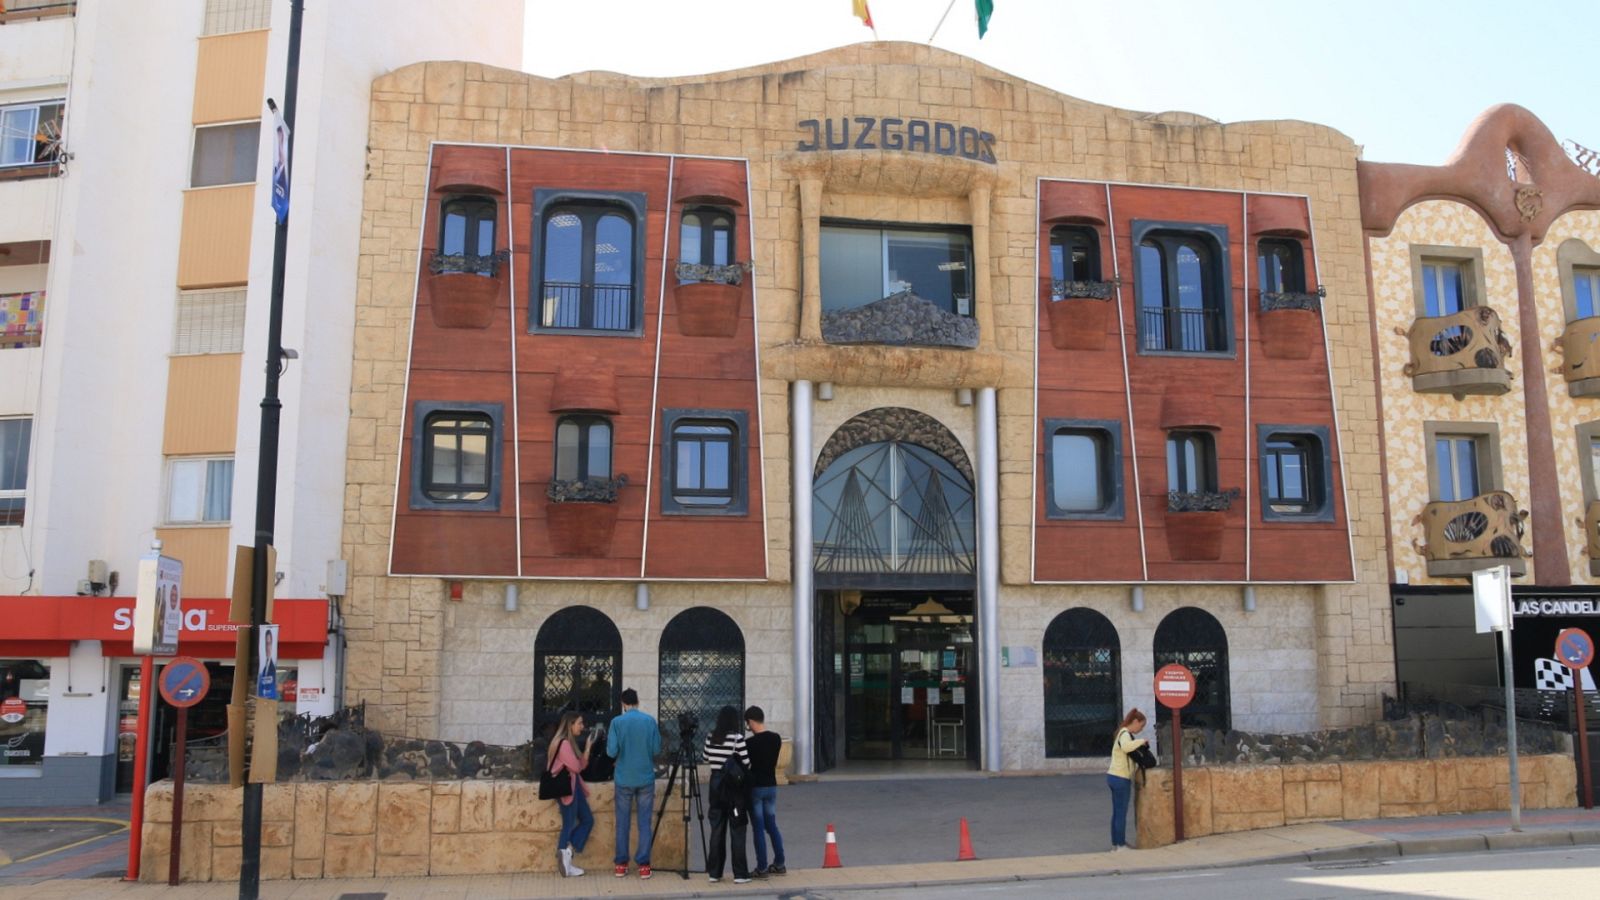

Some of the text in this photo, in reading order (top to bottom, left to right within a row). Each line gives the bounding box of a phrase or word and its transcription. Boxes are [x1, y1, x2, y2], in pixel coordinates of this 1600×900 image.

[798, 117, 997, 164] JUZGADOS
[113, 607, 207, 631] sa
[1512, 600, 1540, 615] LAS
